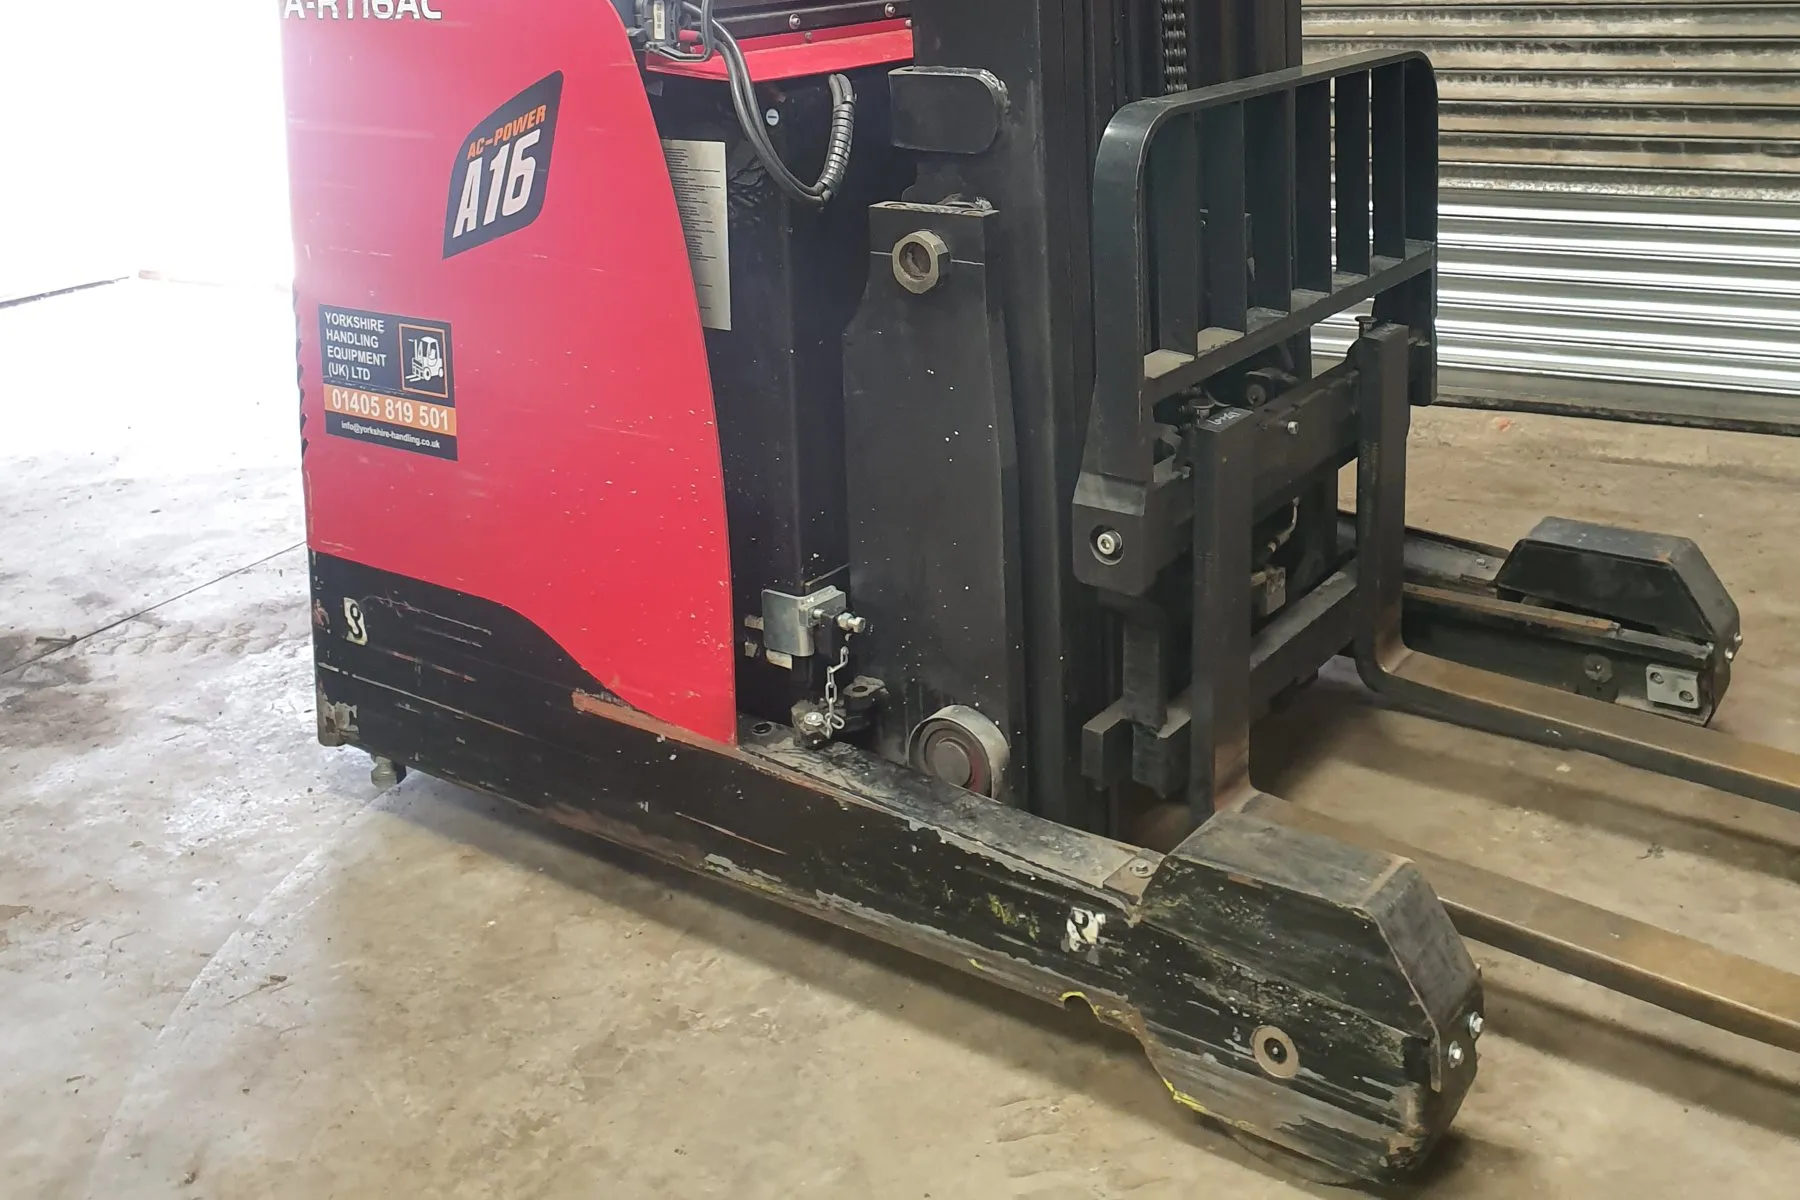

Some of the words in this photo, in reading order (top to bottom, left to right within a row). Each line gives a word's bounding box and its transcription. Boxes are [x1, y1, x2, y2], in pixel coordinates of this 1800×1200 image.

[466, 104, 547, 160] AC-POWER
[452, 129, 540, 239] A16
[324, 311, 386, 333] YORKSHIRE
[326, 328, 379, 348] HANDLING
[327, 345, 387, 367] EQUIPMENT
[328, 362, 350, 380] (UK)
[351, 366, 371, 381] LTD
[332, 388, 381, 417] 01405
[385, 398, 414, 423] 819
[419, 405, 448, 431] 501
[340, 420, 441, 449] info@yorkshire-handling.co.uk
